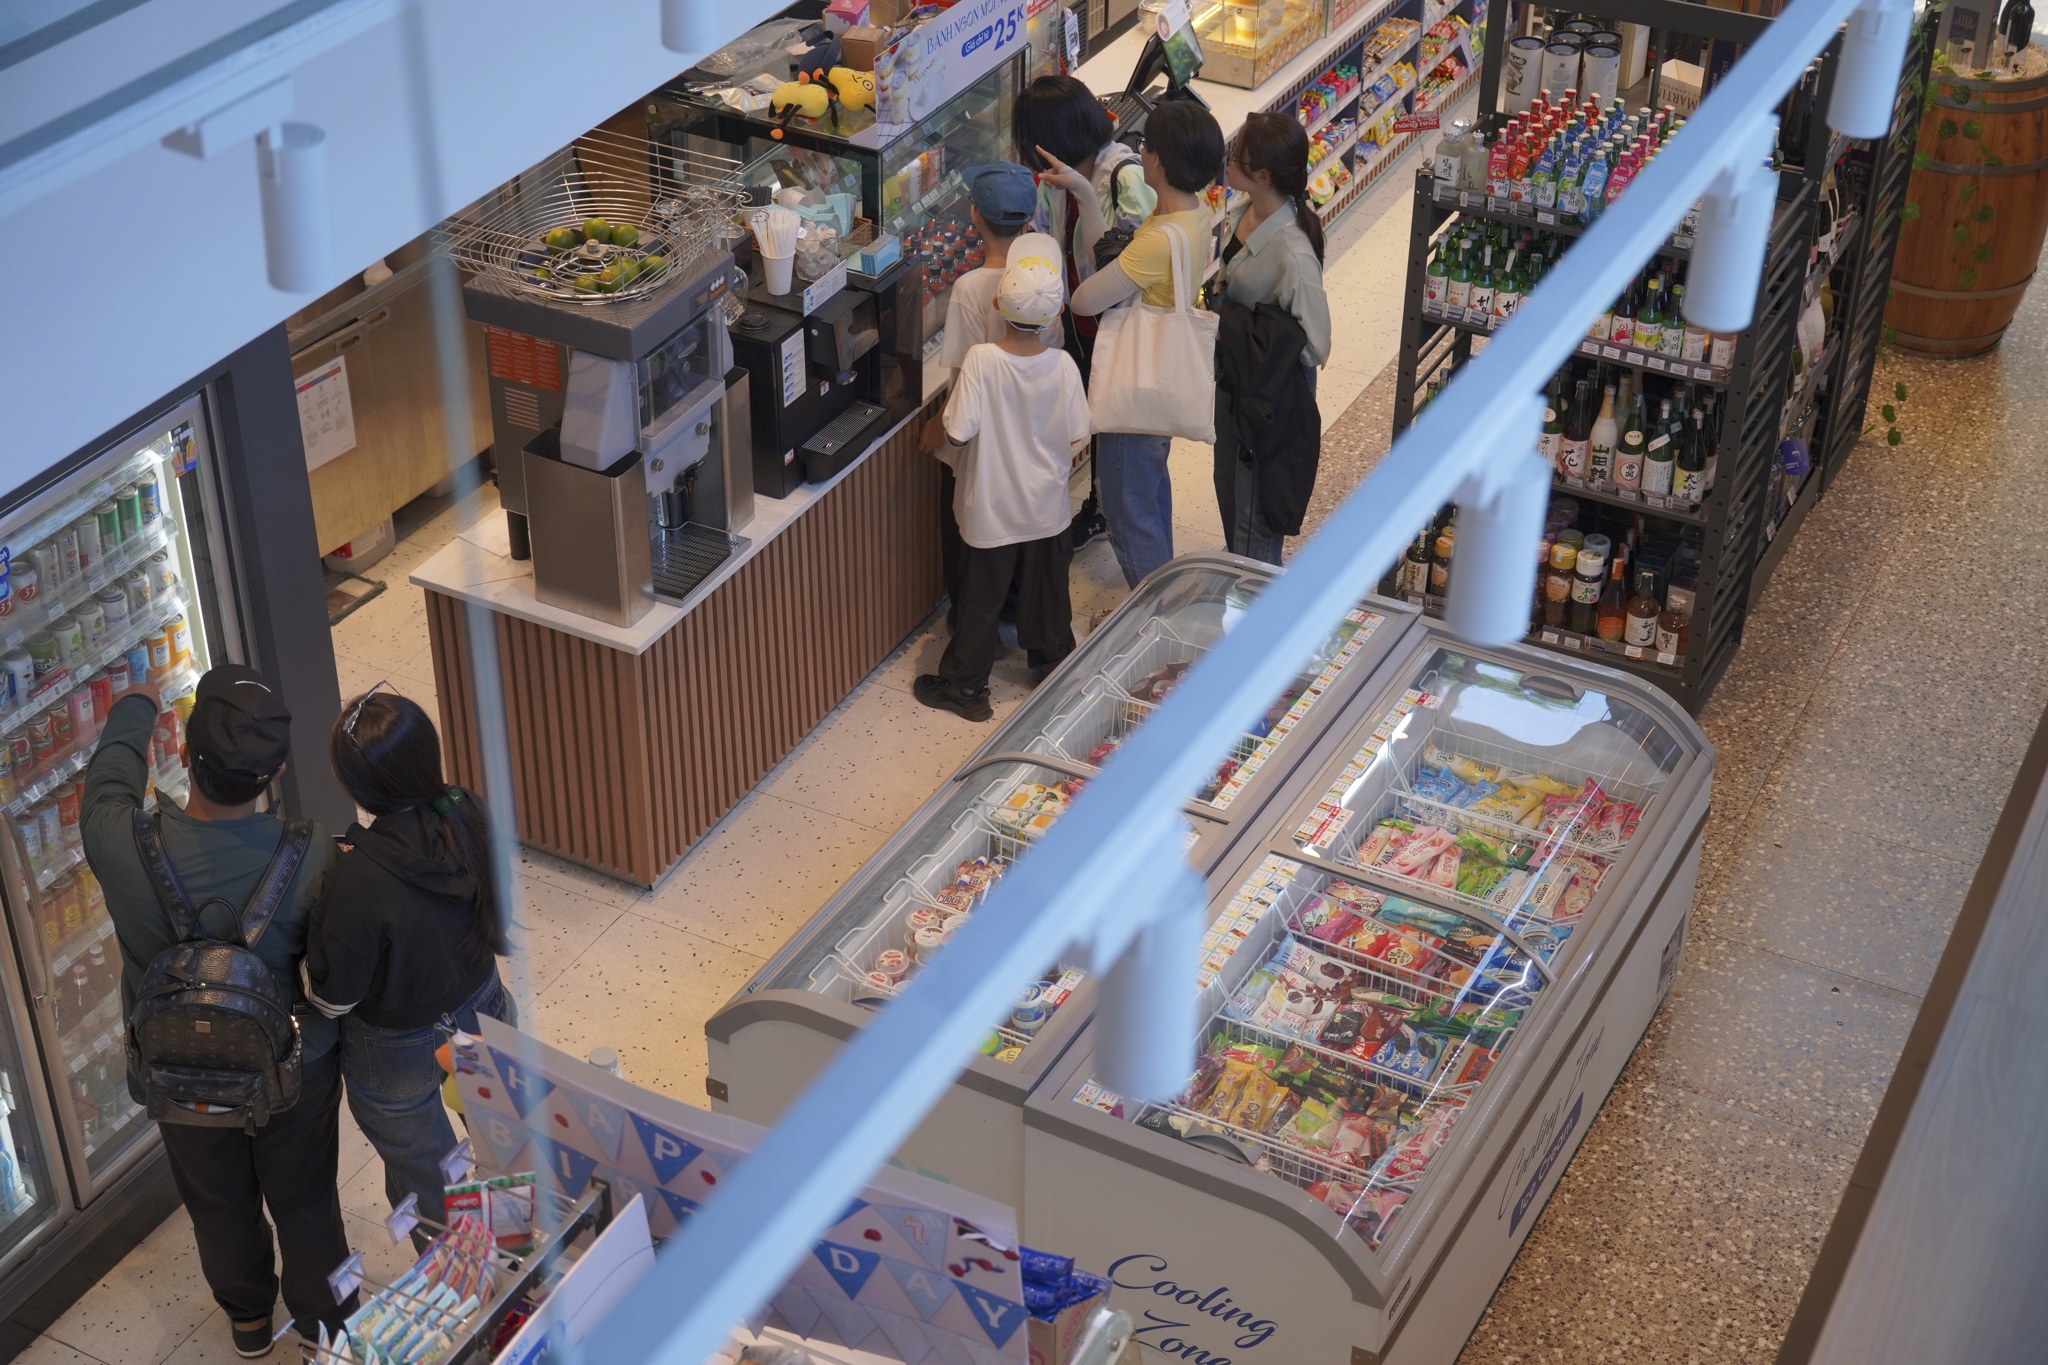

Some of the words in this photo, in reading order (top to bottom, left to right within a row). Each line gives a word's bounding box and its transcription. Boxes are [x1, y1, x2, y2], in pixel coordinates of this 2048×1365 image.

[926, 25, 953, 55] BÁNH
[1535, 883, 1551, 904] YOGURT
[1289, 947, 1305, 970] true
[1318, 1065, 1356, 1081] SNOWBABY
[1519, 1182, 1537, 1215] Ice
[1538, 1116, 1574, 1179] Cream
[1107, 1254, 1279, 1349] Cooling
